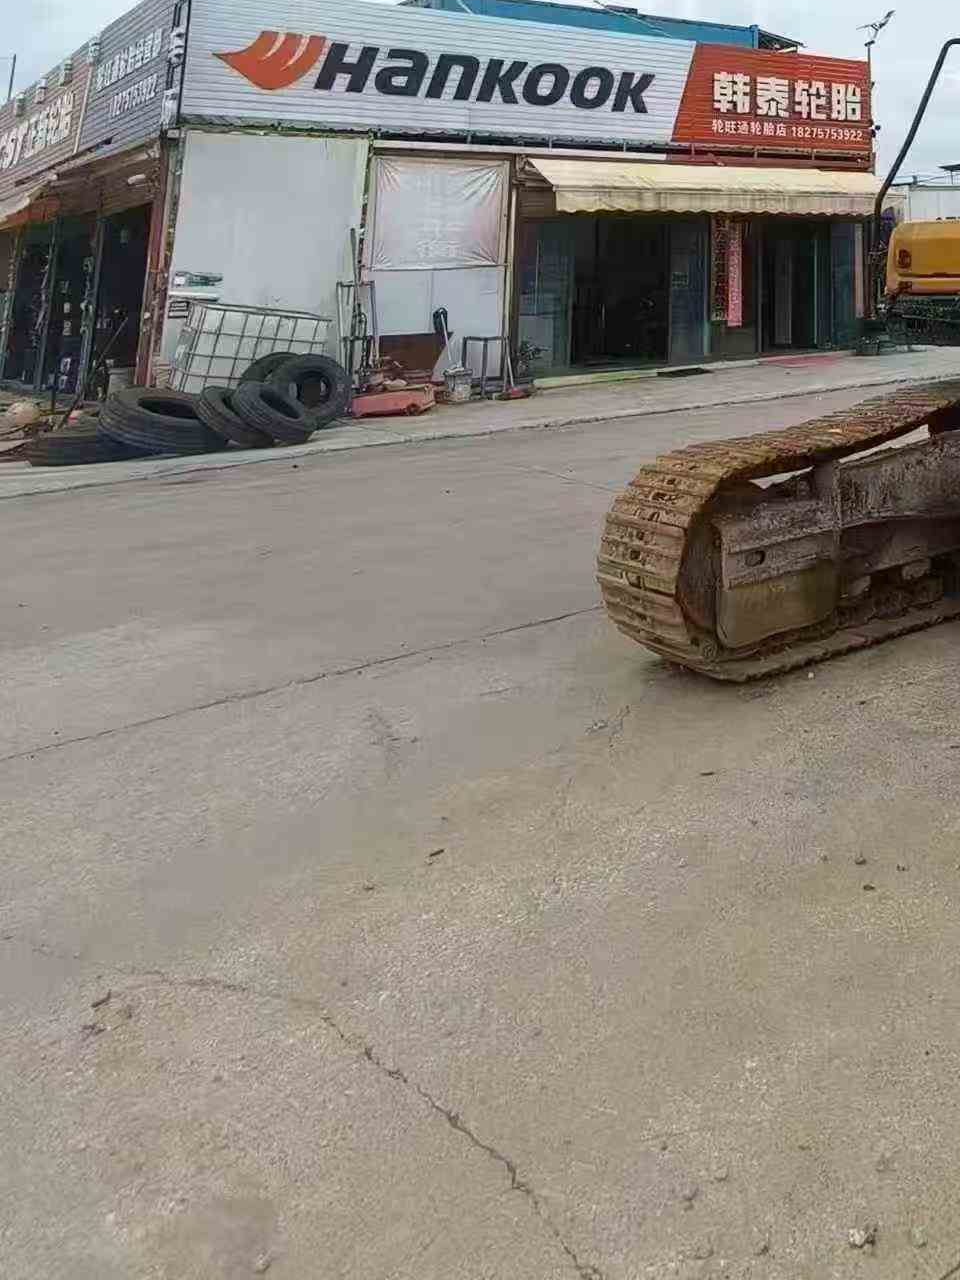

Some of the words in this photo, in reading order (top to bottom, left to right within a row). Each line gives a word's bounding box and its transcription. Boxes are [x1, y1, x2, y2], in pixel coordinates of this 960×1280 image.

[713, 71, 862, 120] 韩泰轮胎
[712, 119, 786, 136] 轮旺通轮胎店
[791, 126, 863, 141] 18275753922
